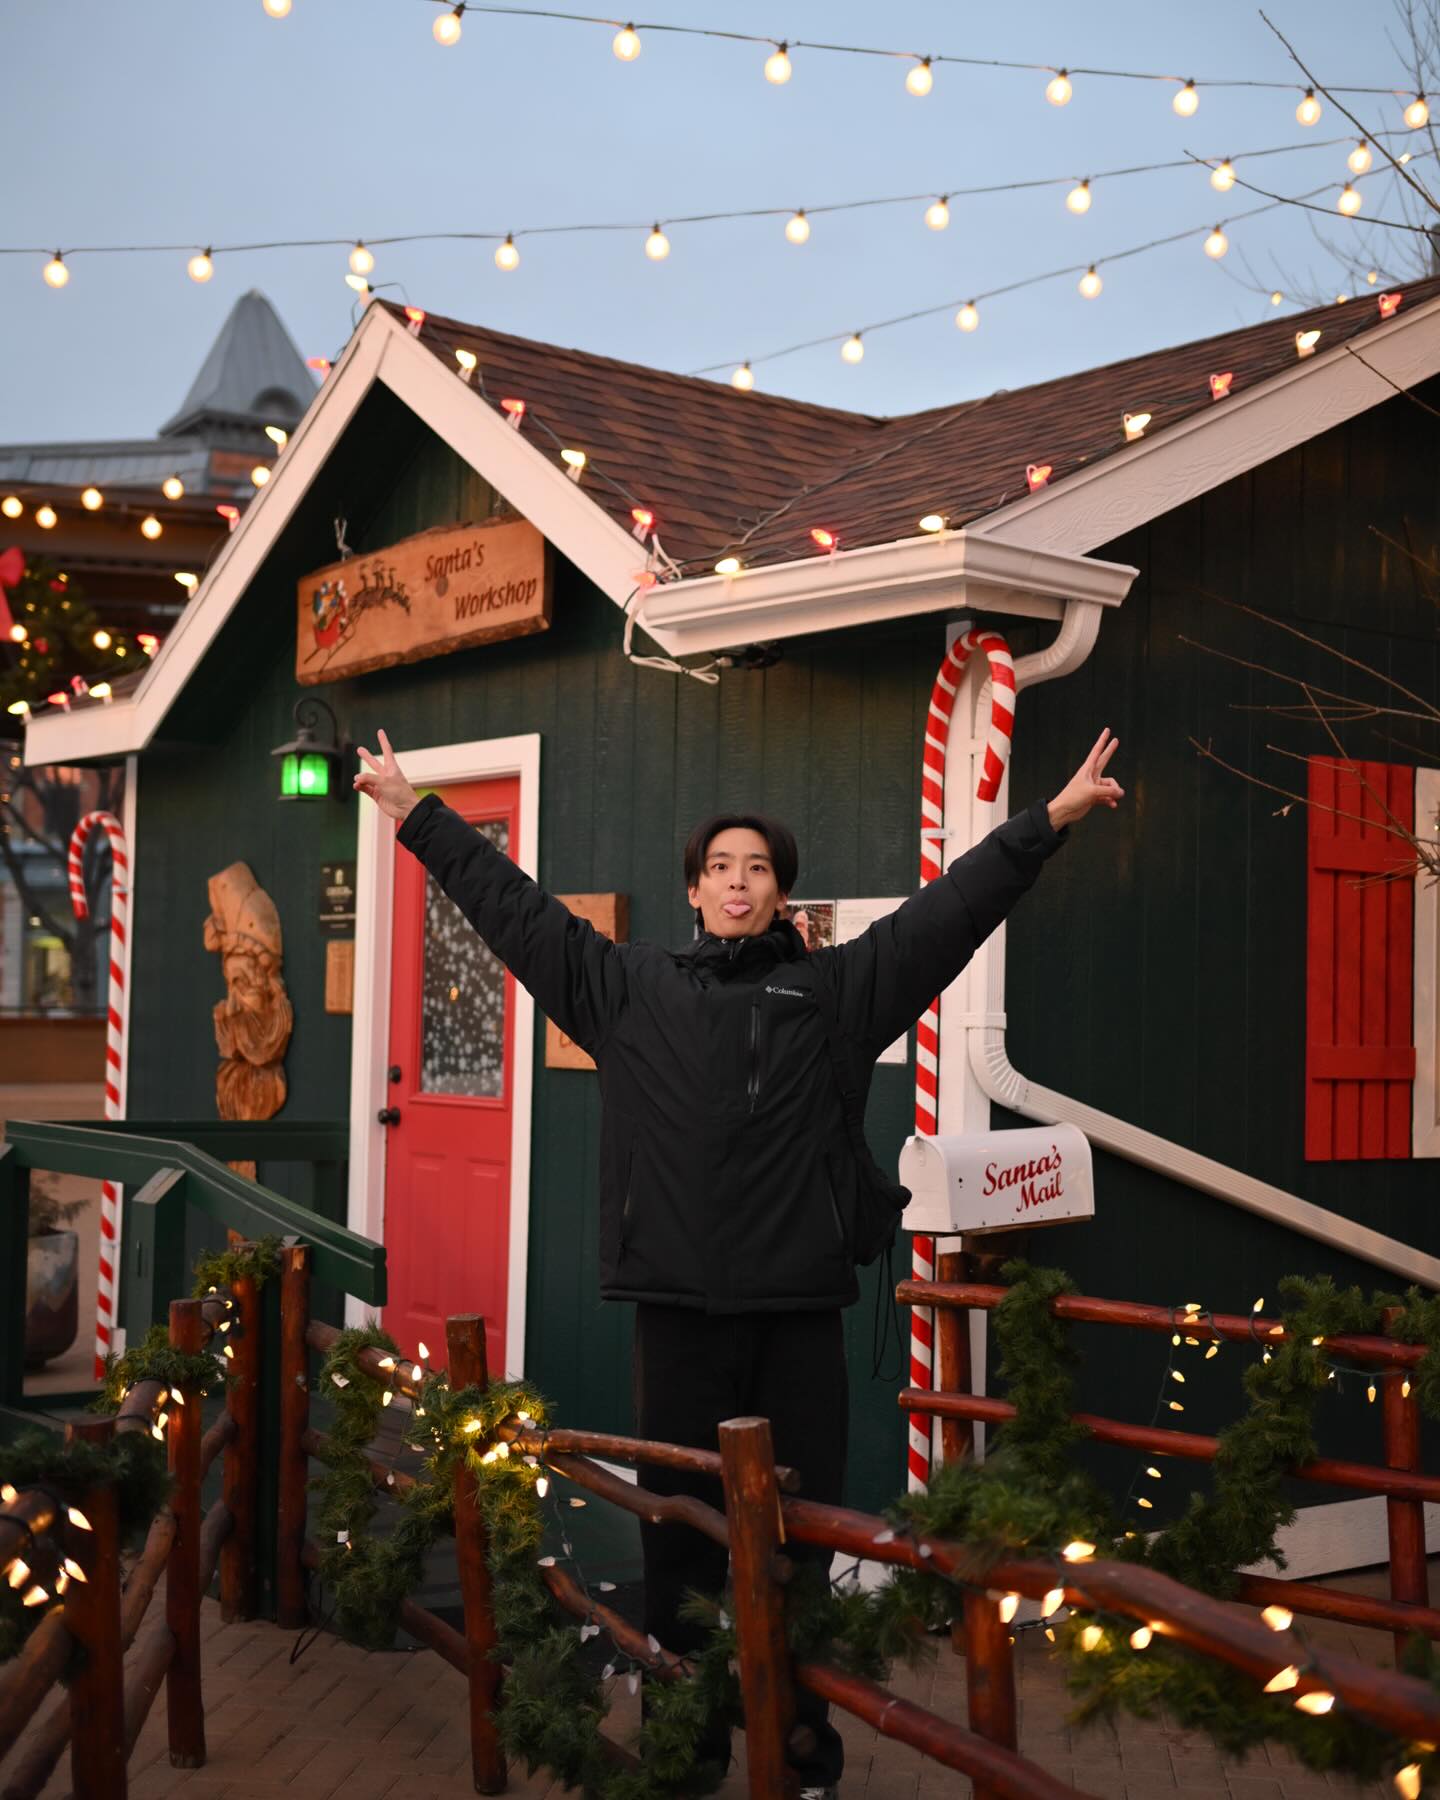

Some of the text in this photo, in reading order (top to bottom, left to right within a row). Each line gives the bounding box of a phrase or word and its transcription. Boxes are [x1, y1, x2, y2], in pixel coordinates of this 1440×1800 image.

[424, 541, 485, 582] Santa's
[455, 578, 537, 620] Workshop
[983, 1144, 1062, 1196] Santa's
[1016, 1171, 1064, 1213] Mail
